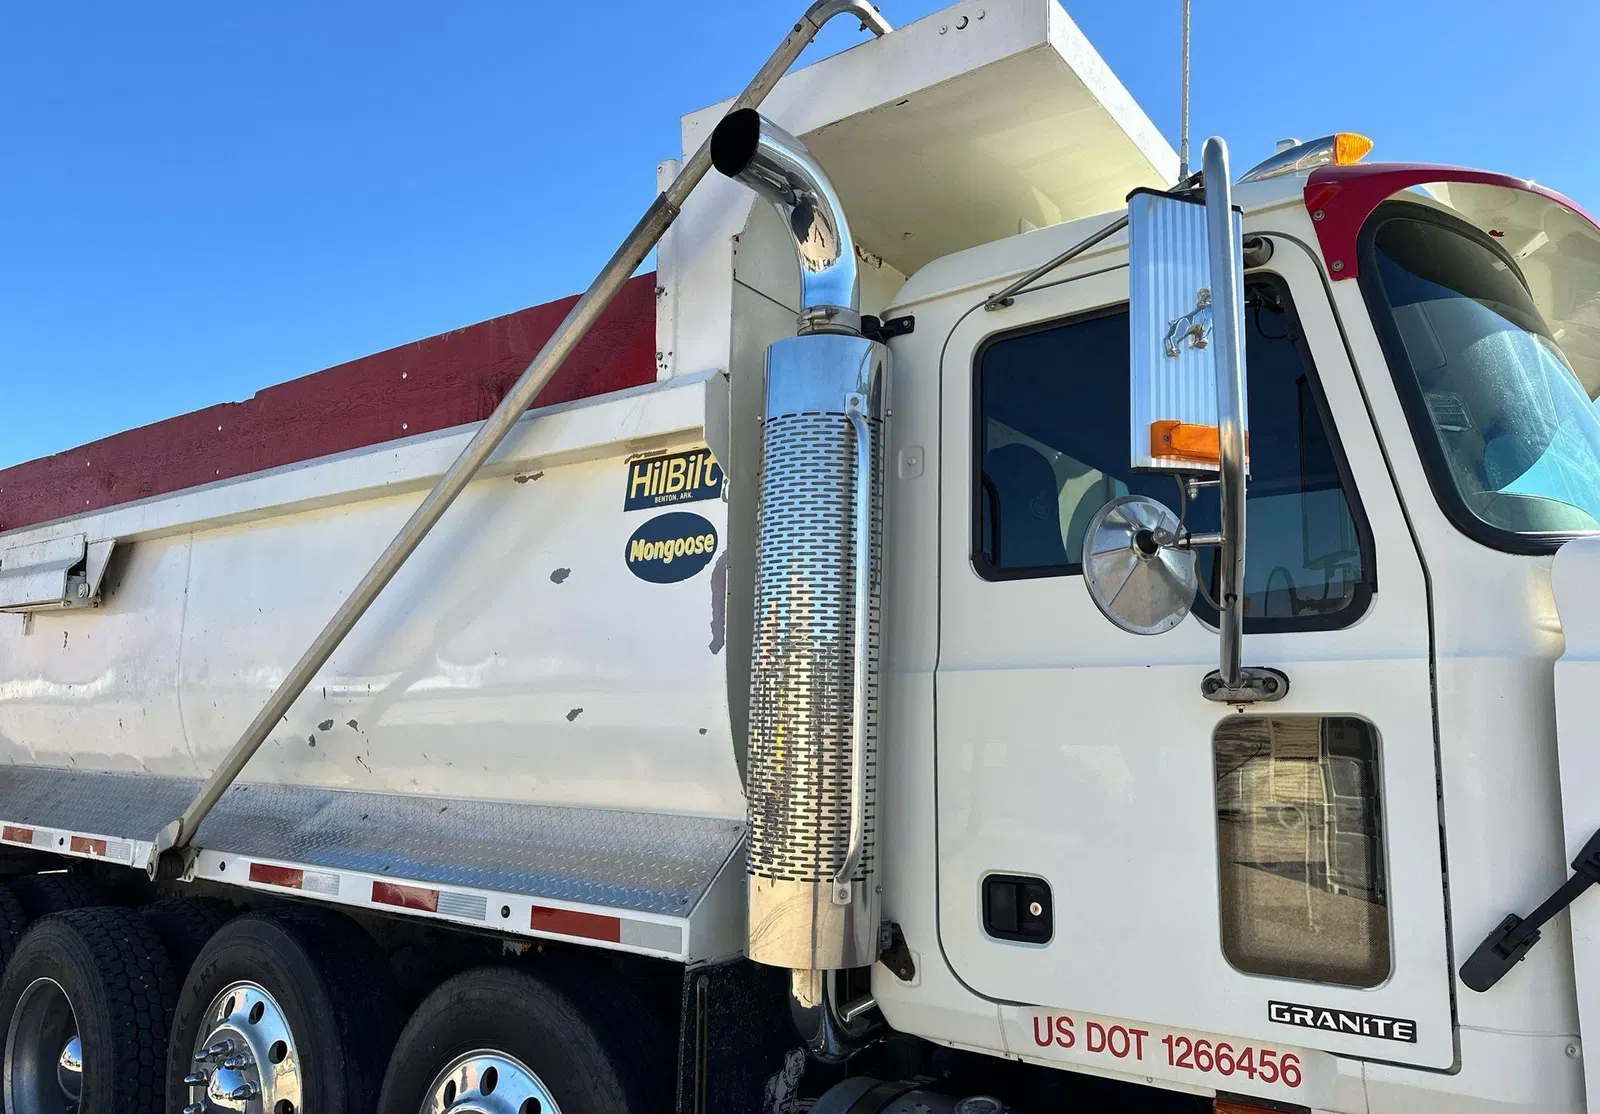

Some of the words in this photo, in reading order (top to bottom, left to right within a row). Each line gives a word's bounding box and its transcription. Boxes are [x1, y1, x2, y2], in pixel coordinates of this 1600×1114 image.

[630, 453, 718, 499] HilBilt
[654, 494, 679, 504] BENTON,
[630, 533, 715, 563] Mongoose
[1033, 1016, 1075, 1048] US
[1086, 1021, 1149, 1060] DOT
[1161, 1034, 1302, 1088] 1266456
